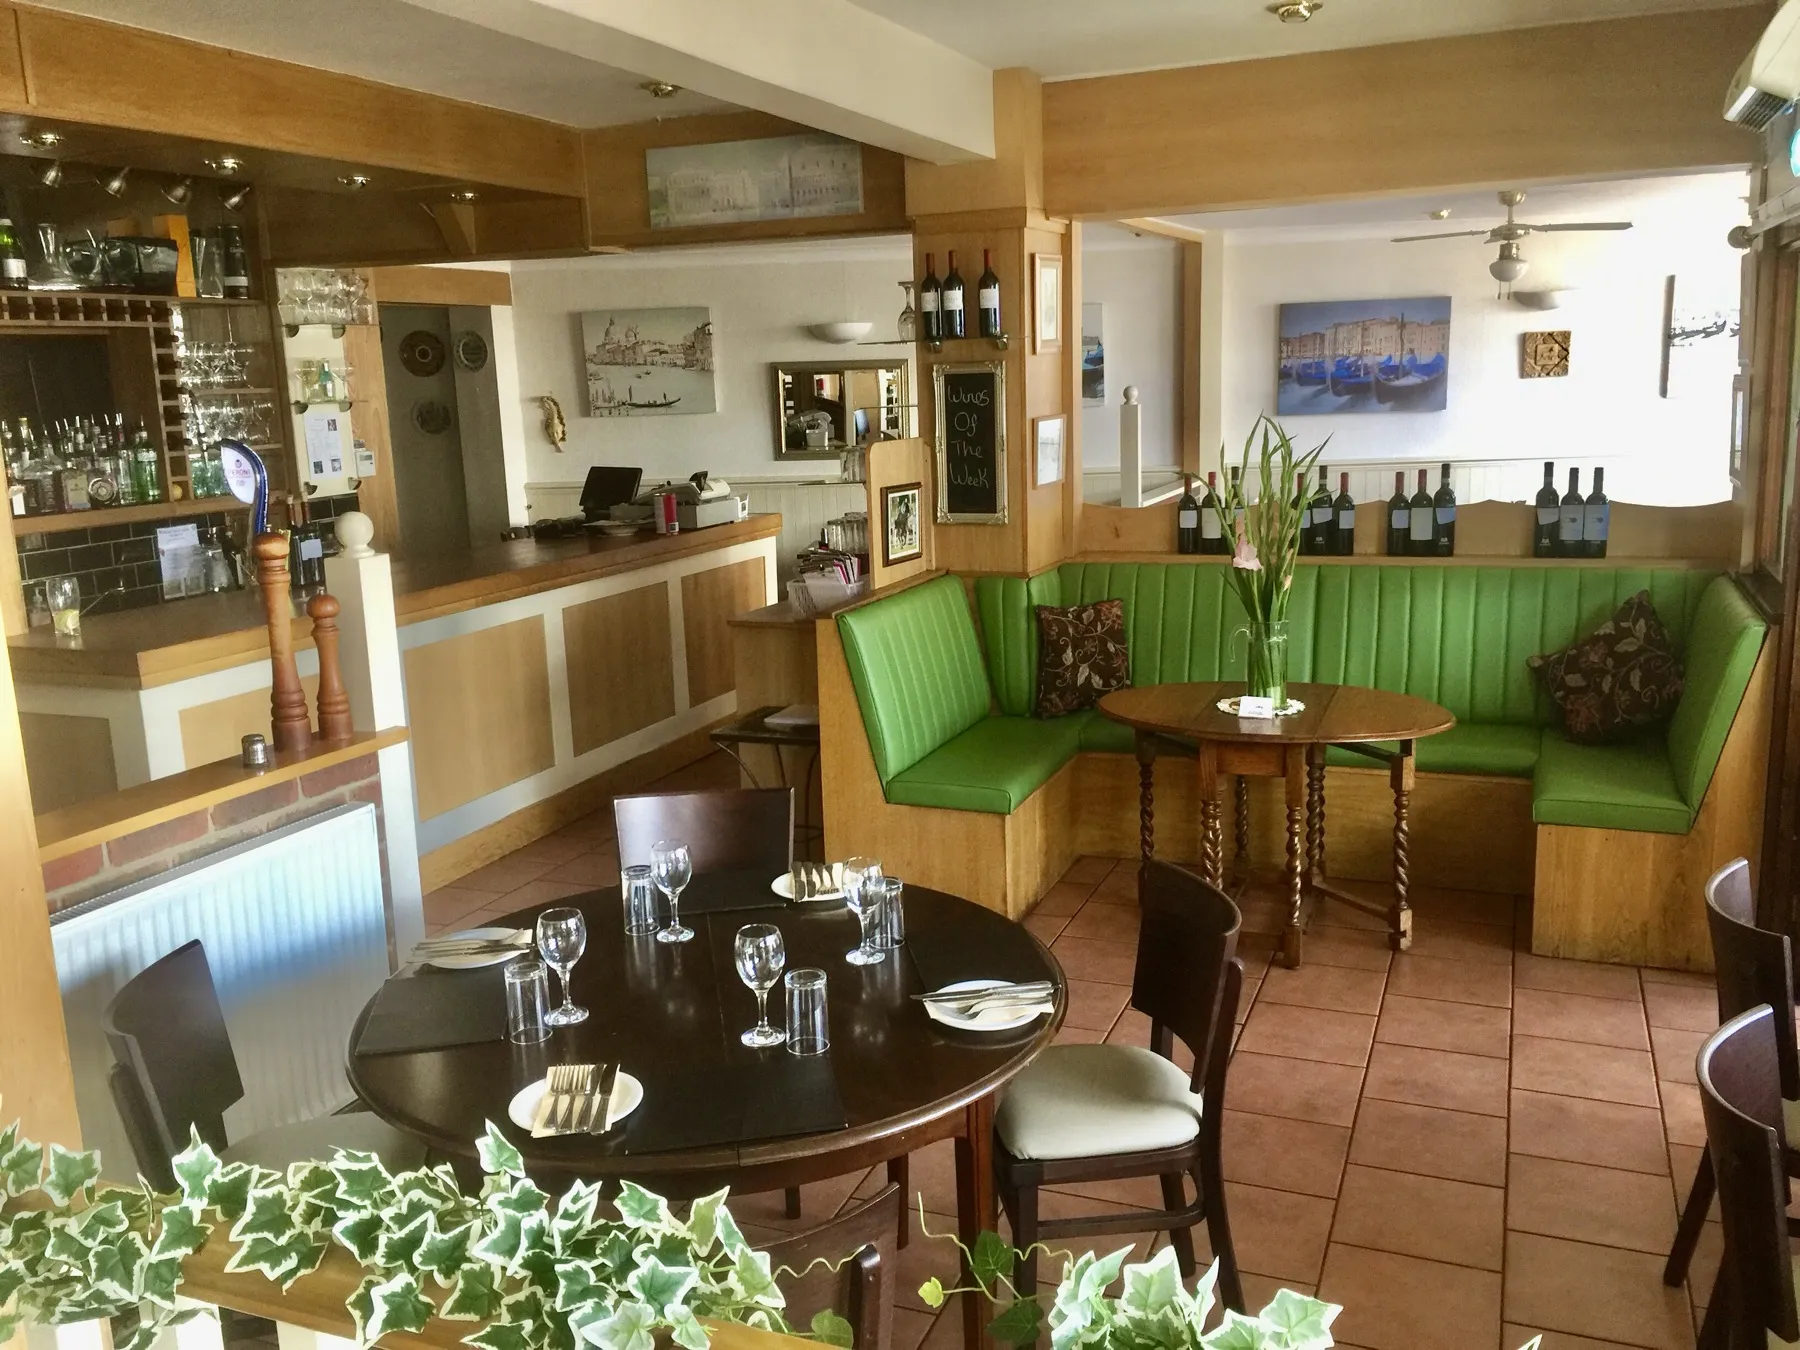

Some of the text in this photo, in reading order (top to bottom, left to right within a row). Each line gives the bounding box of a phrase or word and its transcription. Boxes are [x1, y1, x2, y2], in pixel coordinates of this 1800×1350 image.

[954, 411, 978, 437] Of
[950, 440, 983, 458] The
[227, 468, 251, 477] ERONI
